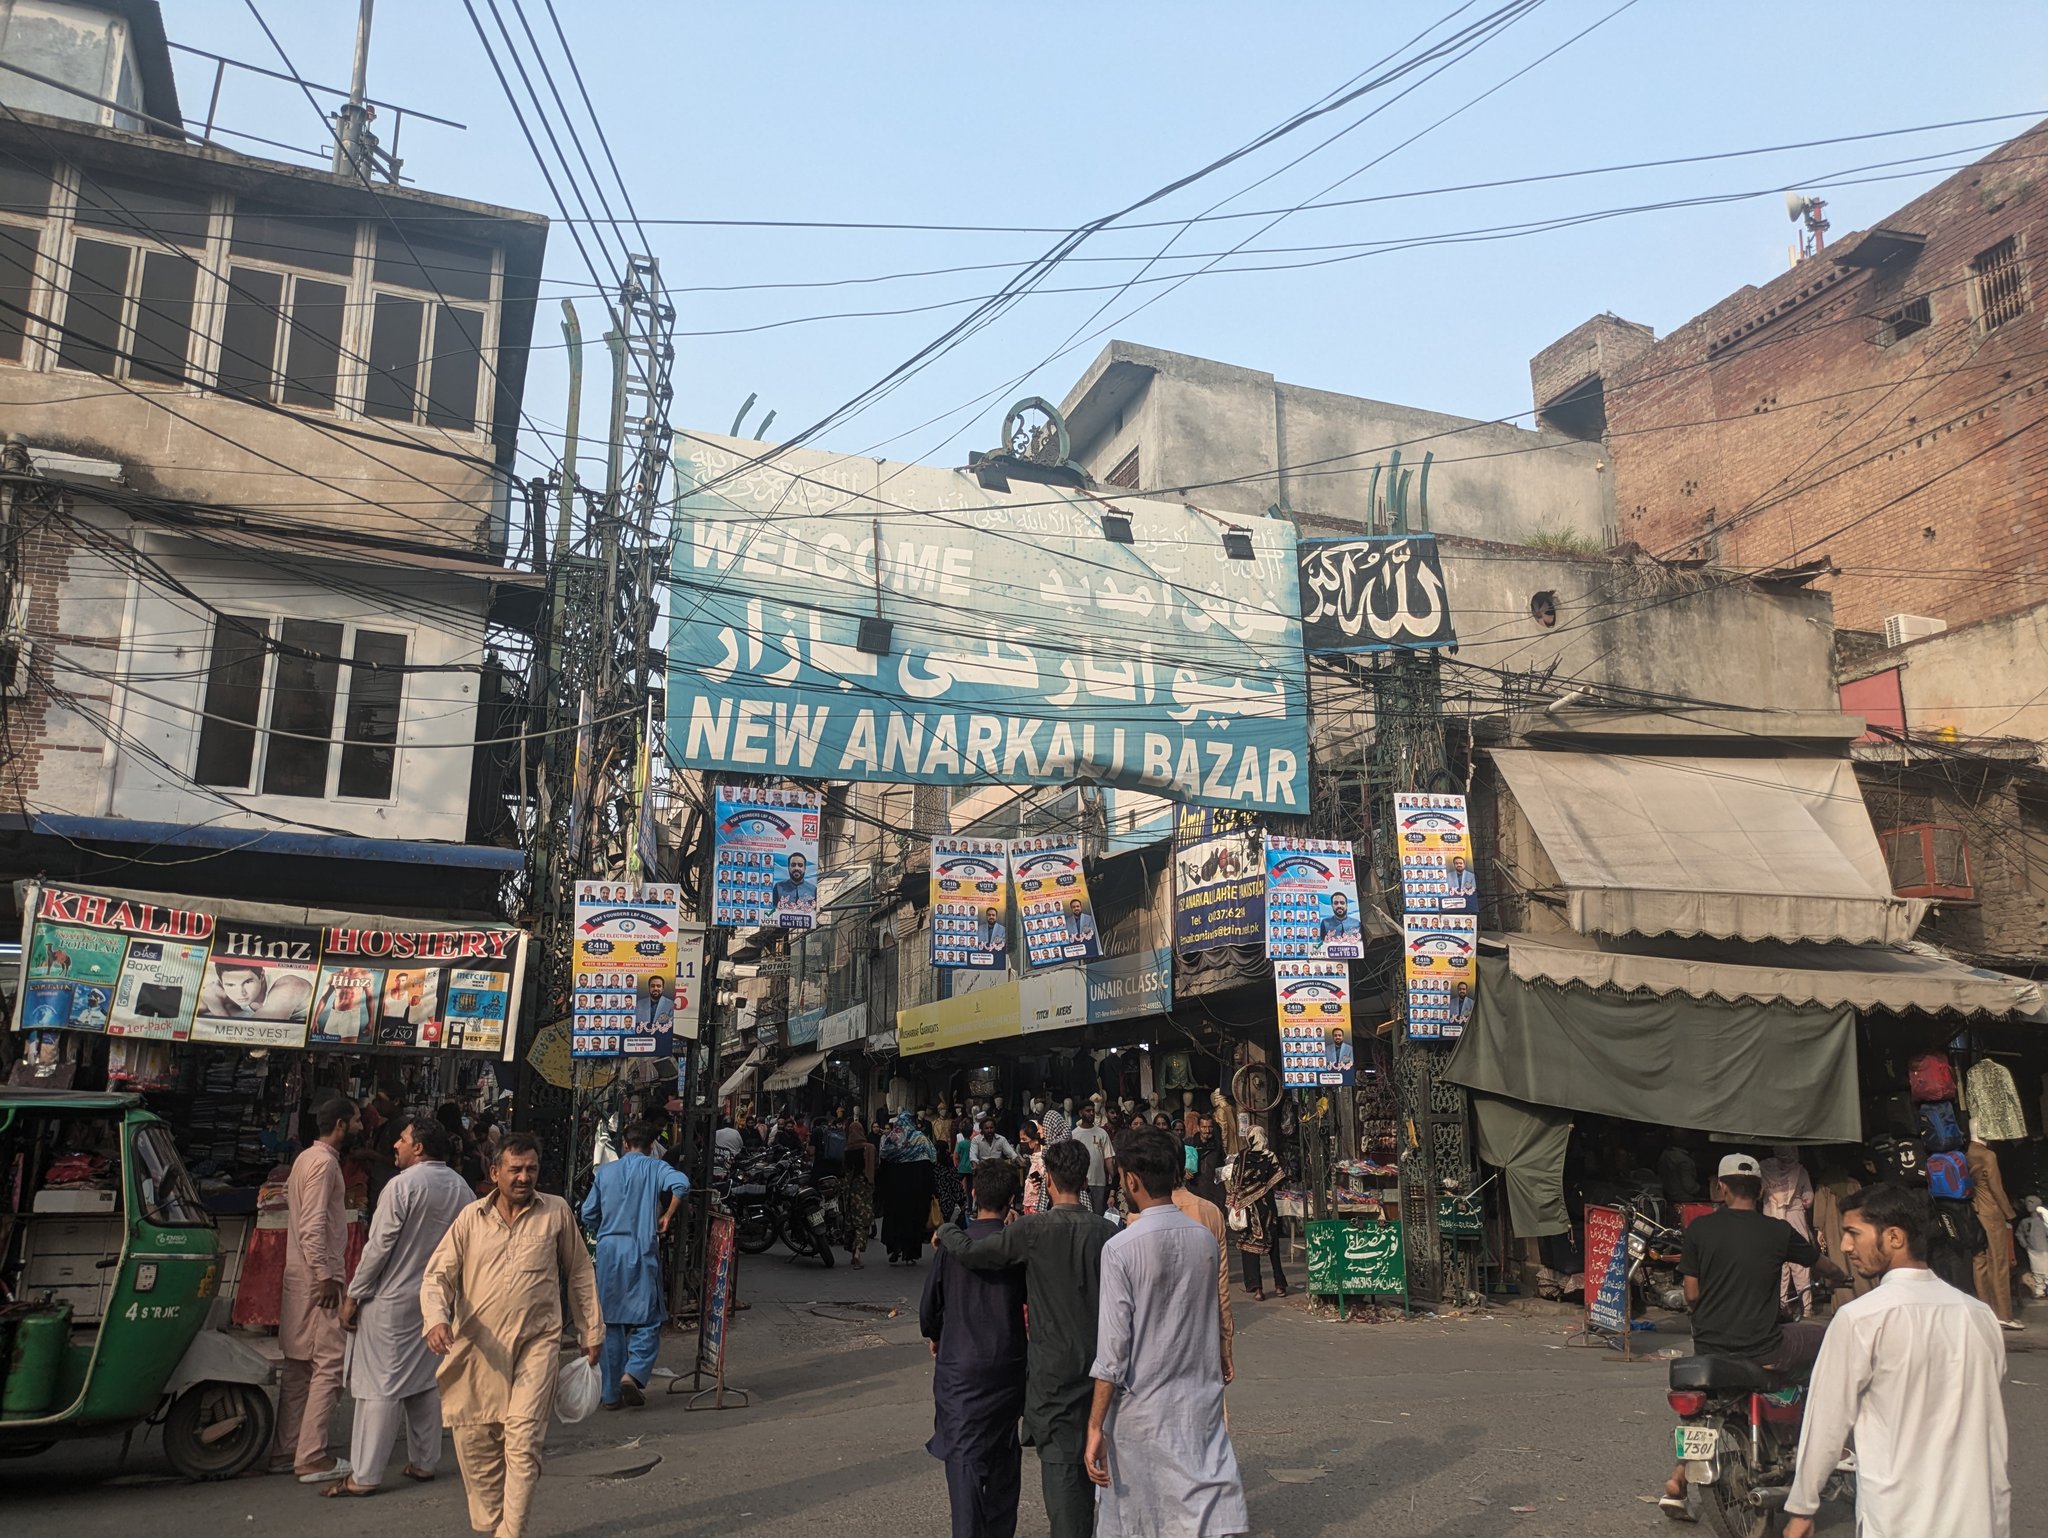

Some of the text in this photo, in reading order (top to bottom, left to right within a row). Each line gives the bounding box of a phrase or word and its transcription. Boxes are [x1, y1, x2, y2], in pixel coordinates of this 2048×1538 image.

[692, 518, 974, 598] WELCOME
[685, 695, 1299, 806] NEW ANARKALI BAZAR
[804, 824, 816, 833] 24
[1177, 804, 1206, 849] Amin
[1341, 867, 1352, 875] 24
[37, 888, 214, 940] KHALID
[592, 915, 603, 924] PIAF
[603, 911, 630, 920] FOUNDERS
[640, 913, 662, 926] ALLIANCE
[224, 932, 312, 961] Hinz
[325, 927, 521, 960] HOSIERY
[587, 941, 609, 949] 24th
[640, 943, 661, 951] VOTE
[133, 949, 158, 959] CHASE
[127, 960, 162, 973] Boxer
[153, 972, 185, 984] Short
[331, 975, 372, 988] Hinz
[457, 972, 498, 982] mercury
[1090, 979, 1123, 1002] UMAIR
[127, 1020, 172, 1034] 1er-Pack
[214, 1025, 291, 1039] MEN'S VEST
[125, 1302, 138, 1321] 4
[1687, 1430, 1701, 1441] LE
